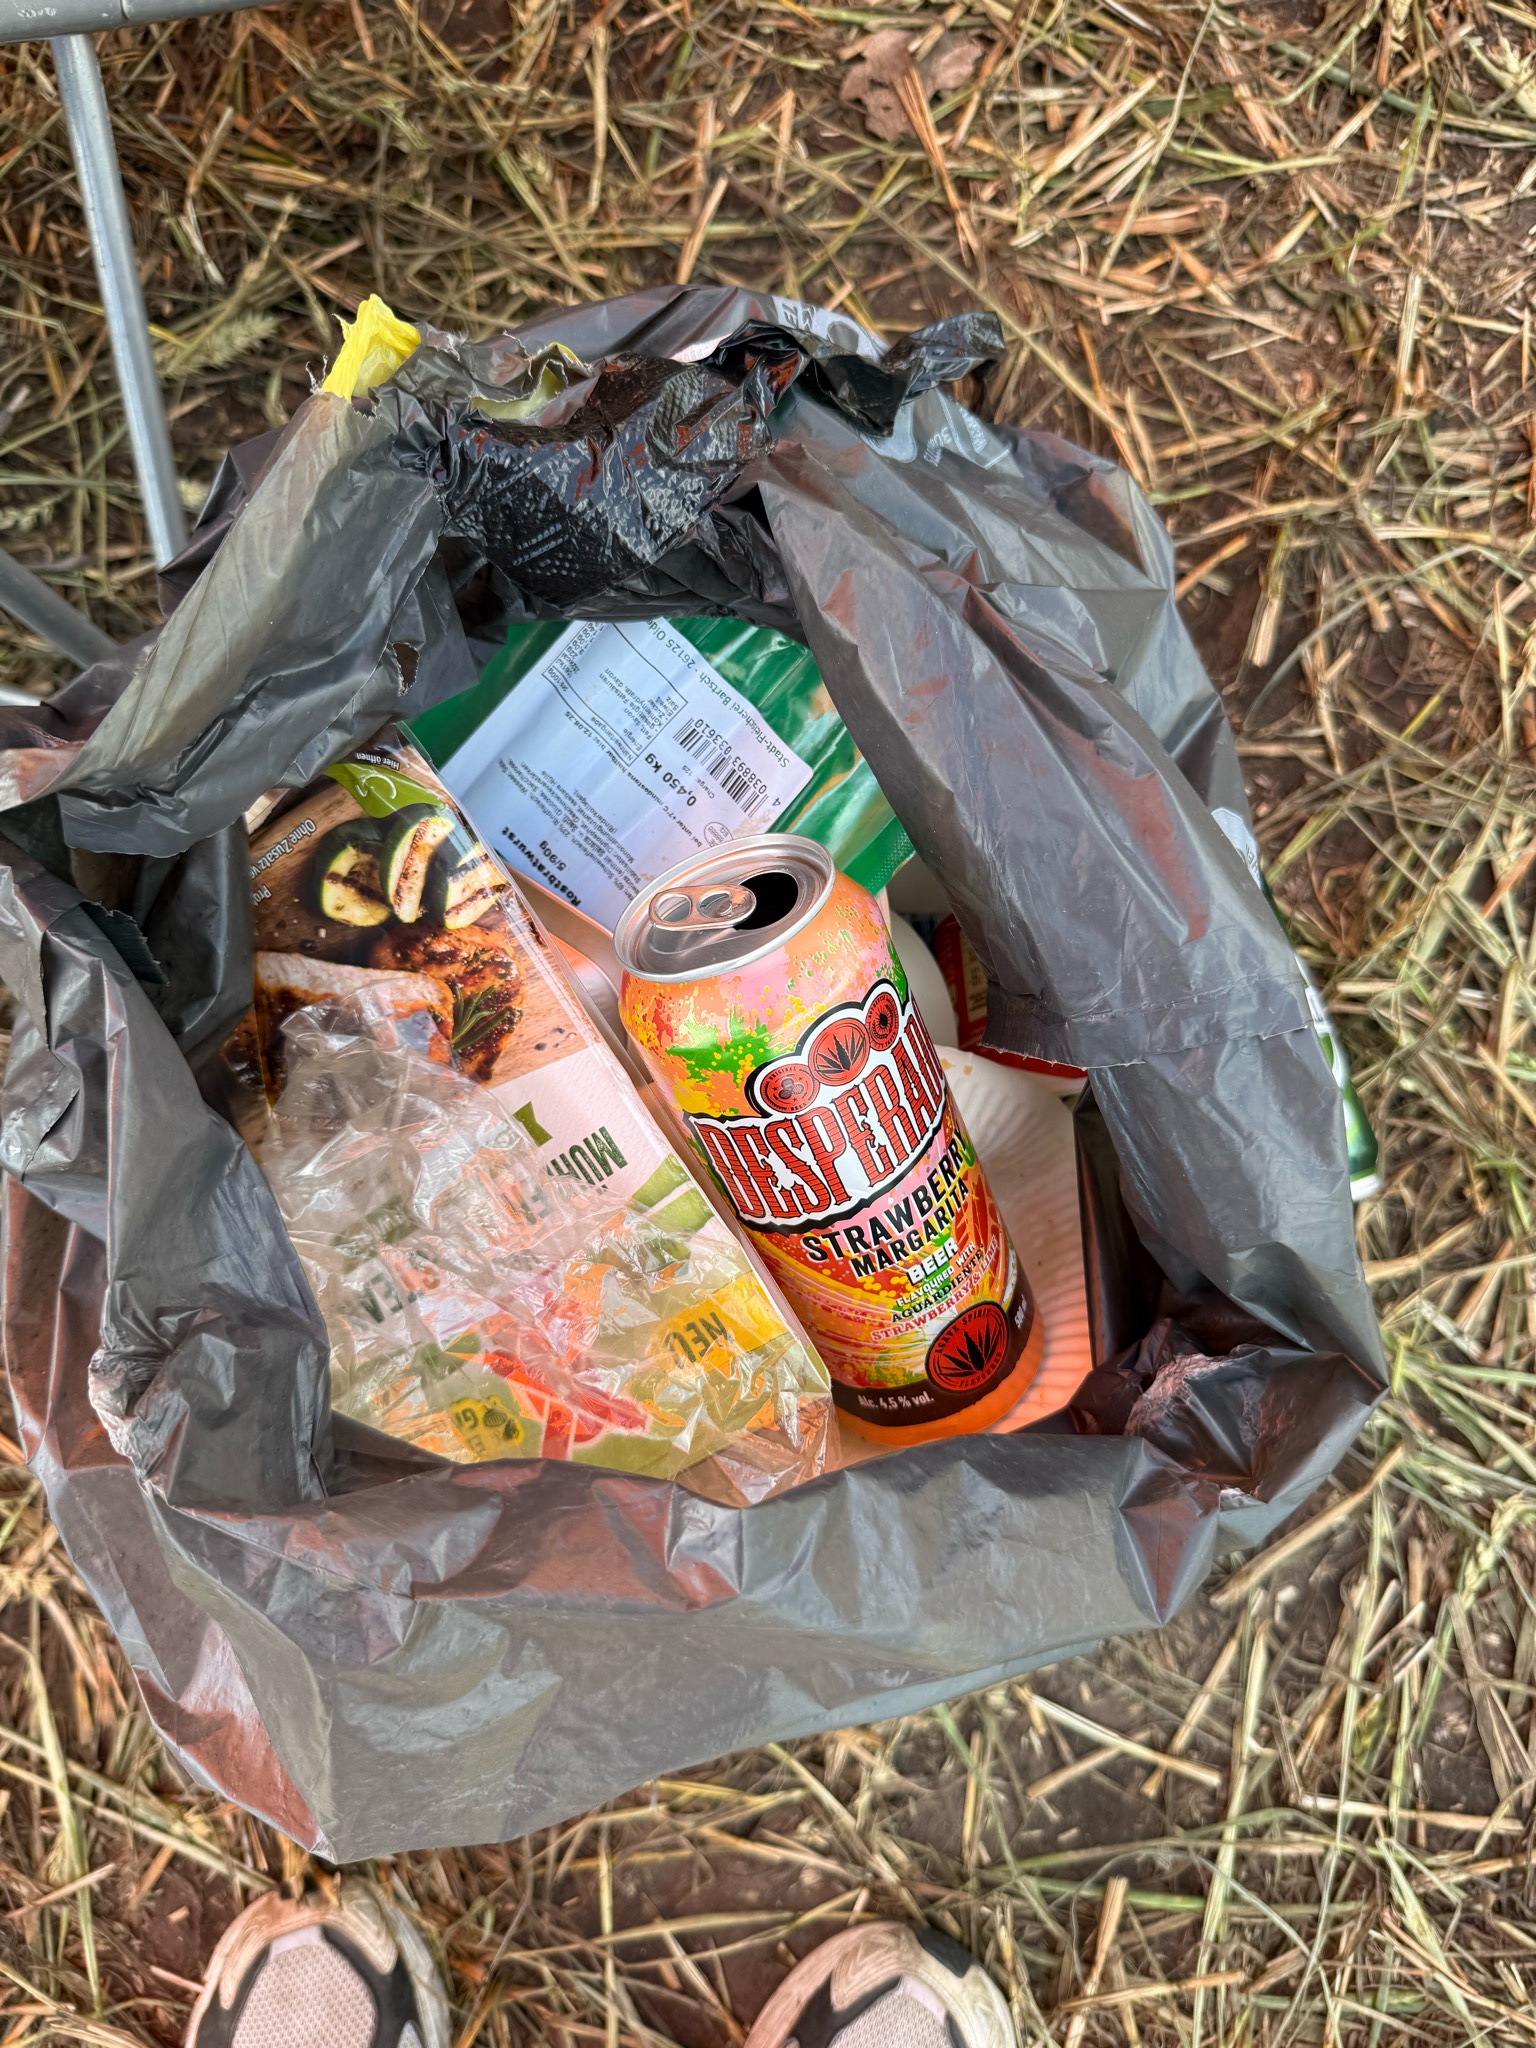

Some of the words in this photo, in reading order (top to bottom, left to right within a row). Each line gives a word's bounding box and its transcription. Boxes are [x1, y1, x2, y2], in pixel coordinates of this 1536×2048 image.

[665, 637, 696, 669] 26125
[603, 667, 624, 688] davon
[696, 671, 731, 706] Bartsch
[622, 707, 641, 726] davon
[693, 716, 733, 756] 033610
[726, 701, 792, 768] Stadt-Fleischerei
[381, 756, 400, 769] Hier
[603, 749, 627, 773] haltbar
[642, 751, 664, 773] kg
[729, 755, 769, 795] 038893
[626, 769, 663, 808] mindestens
[660, 768, 699, 807] 0,450
[771, 796, 782, 808] 4
[287, 817, 318, 847] Ohne
[676, 819, 693, 836] unter
[690, 835, 702, 847] bei
[256, 838, 293, 872] Zusatz
[499, 825, 582, 909] Rostbratwurst
[536, 839, 569, 872] 5/90g
[801, 1130, 968, 1263] STRAWBERRY
[848, 1176, 969, 1280] MARGARITA
[896, 1266, 954, 1307] FLAVOURED
[956, 1242, 976, 1268] WITH
[907, 1237, 959, 1286] BEER
[871, 1283, 971, 1341] STRAWBERRY
[979, 1234, 999, 1274] LIME
[934, 1323, 959, 1354] AGAVE
[961, 1307, 992, 1326] SPIRIT
[858, 1393, 878, 1409] Alc.
[896, 1396, 910, 1412] %
[911, 1393, 934, 1408] vol.
